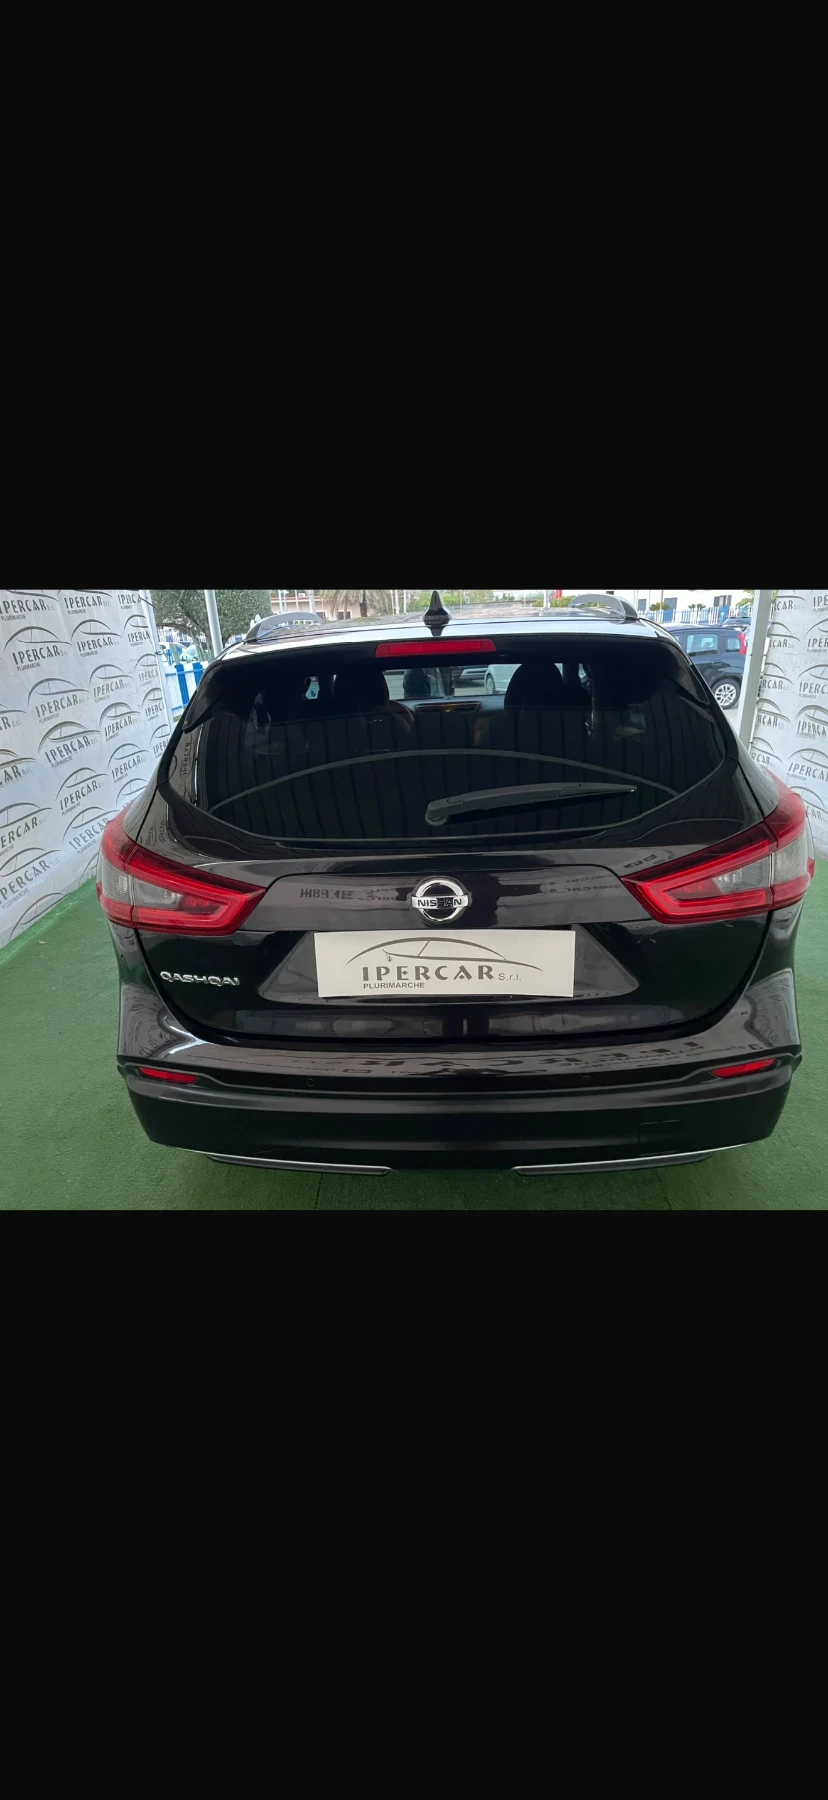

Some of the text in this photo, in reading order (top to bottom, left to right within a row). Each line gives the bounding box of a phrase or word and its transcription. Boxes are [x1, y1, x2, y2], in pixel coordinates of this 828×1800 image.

[64, 596, 103, 609] IPERCAR
[77, 636, 113, 652] IPERCAR
[12, 644, 60, 665] IPERCAR
[94, 679, 125, 698] IPERCAR
[35, 693, 79, 718] IPERCAR
[104, 715, 132, 738] IPERCAR
[45, 735, 91, 764] IPERCAR
[112, 755, 141, 780] IPERCAR
[60, 779, 98, 811] IPERCAR
[417, 898, 462, 907] NISSAN
[160, 971, 240, 987] QASHQAI
[362, 965, 522, 981] IPERCAR S.r.l.
